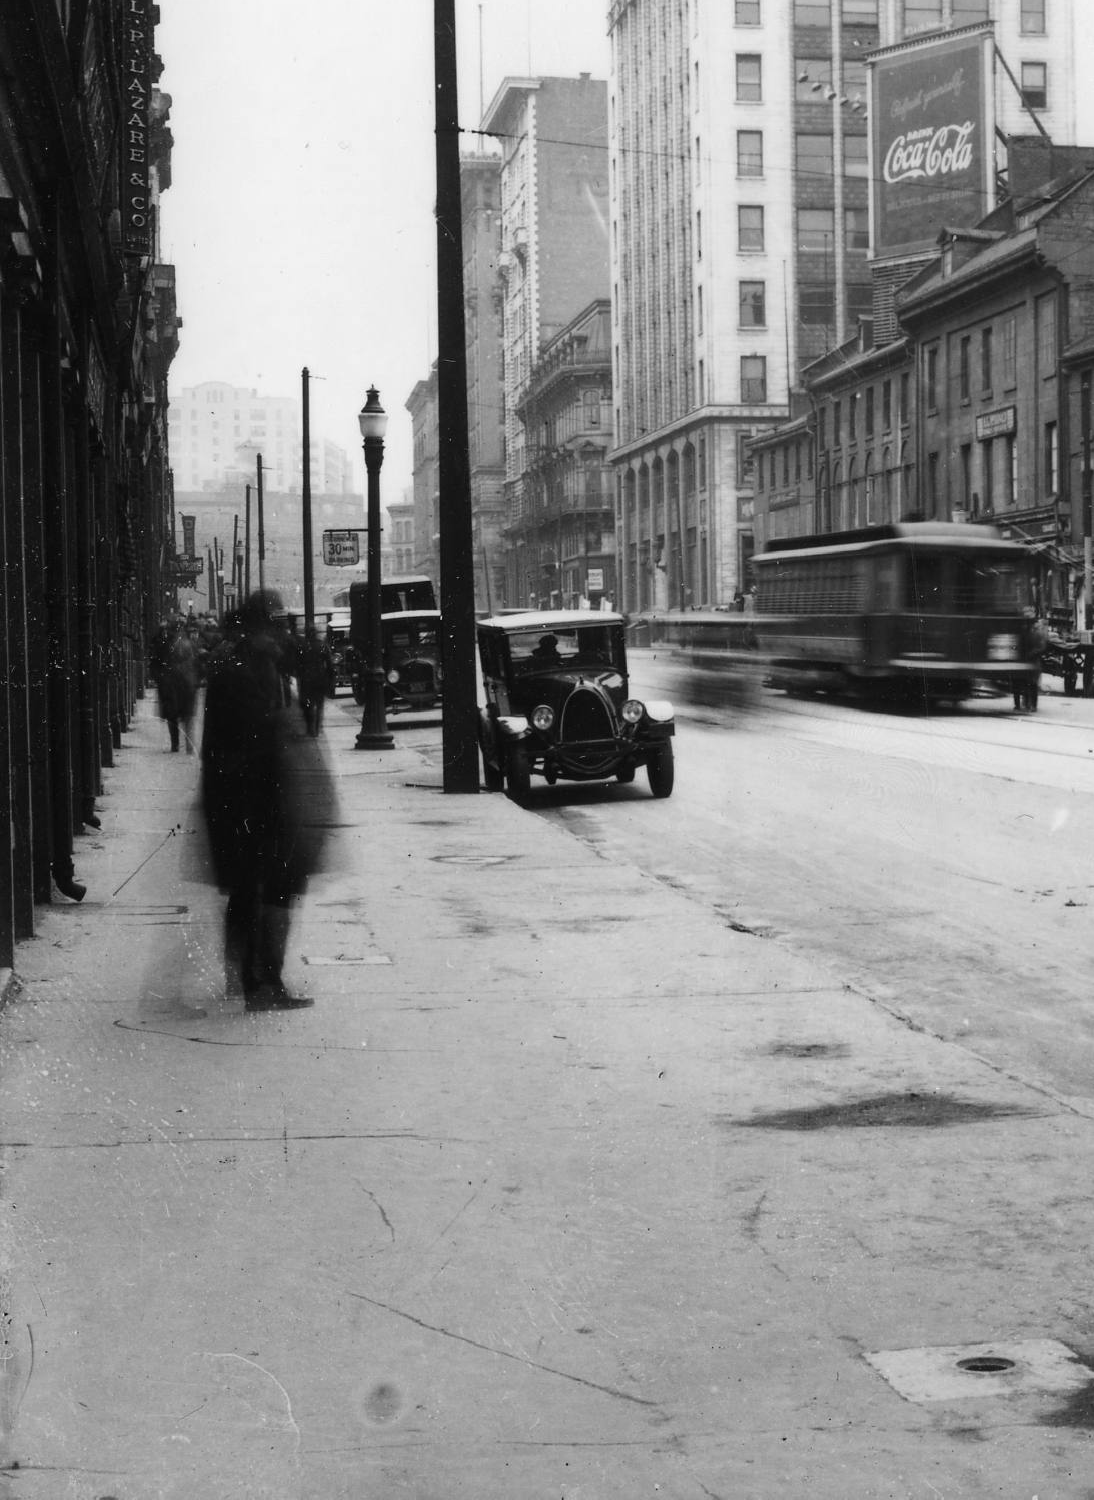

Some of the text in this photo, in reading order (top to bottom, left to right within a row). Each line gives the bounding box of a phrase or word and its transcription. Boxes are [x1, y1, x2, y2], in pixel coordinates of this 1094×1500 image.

[128, 59, 146, 163] LAZARE
[883, 120, 976, 183] Coca-Cola
[130, 173, 146, 188] &
[328, 543, 342, 556] 30
